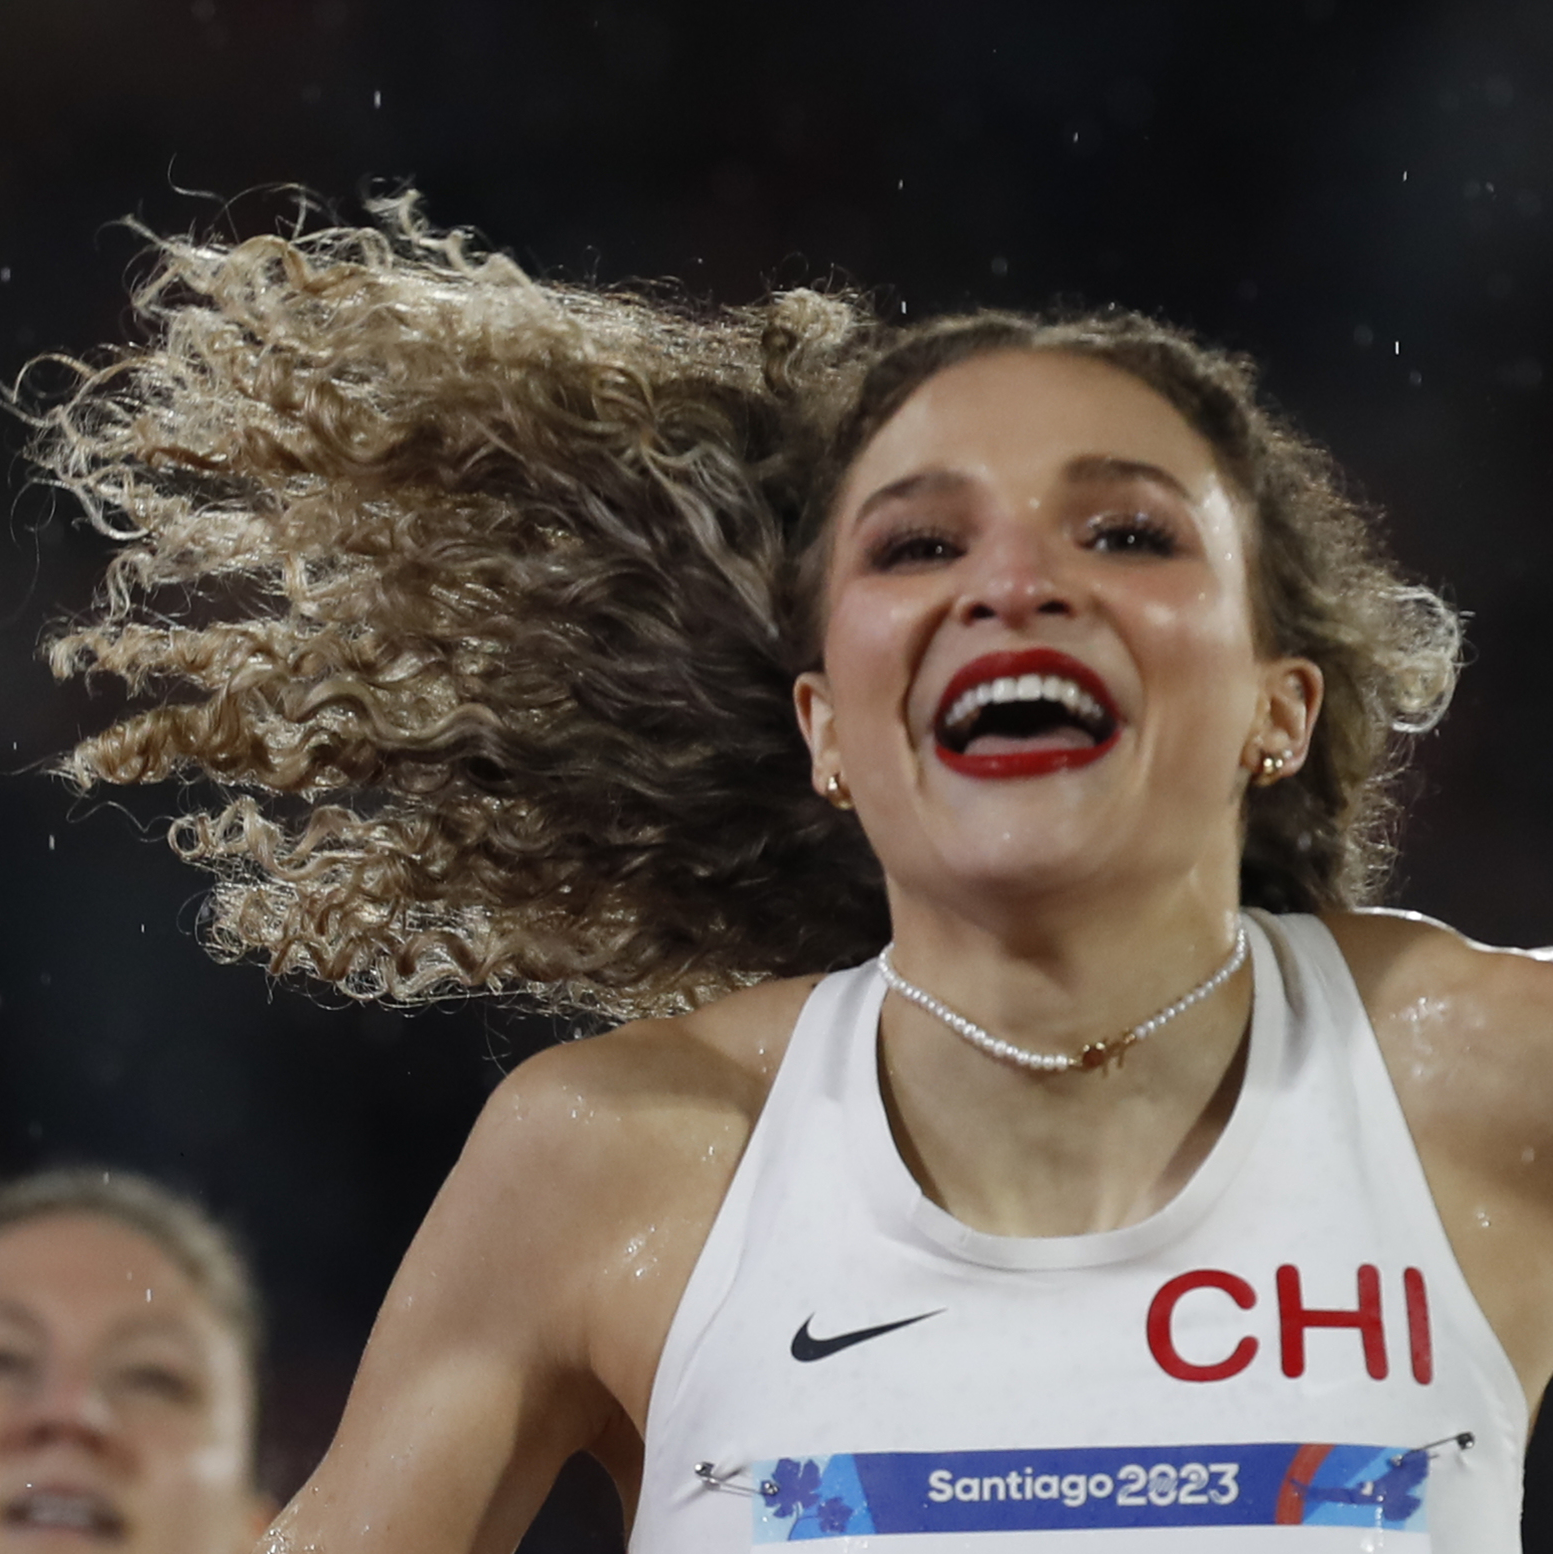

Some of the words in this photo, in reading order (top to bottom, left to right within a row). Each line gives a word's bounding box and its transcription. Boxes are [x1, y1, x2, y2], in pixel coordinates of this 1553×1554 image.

[1146, 1263, 1433, 1385] CHI
[928, 1467, 1114, 1507] Santiago
[1116, 1463, 1240, 1507] 2023
